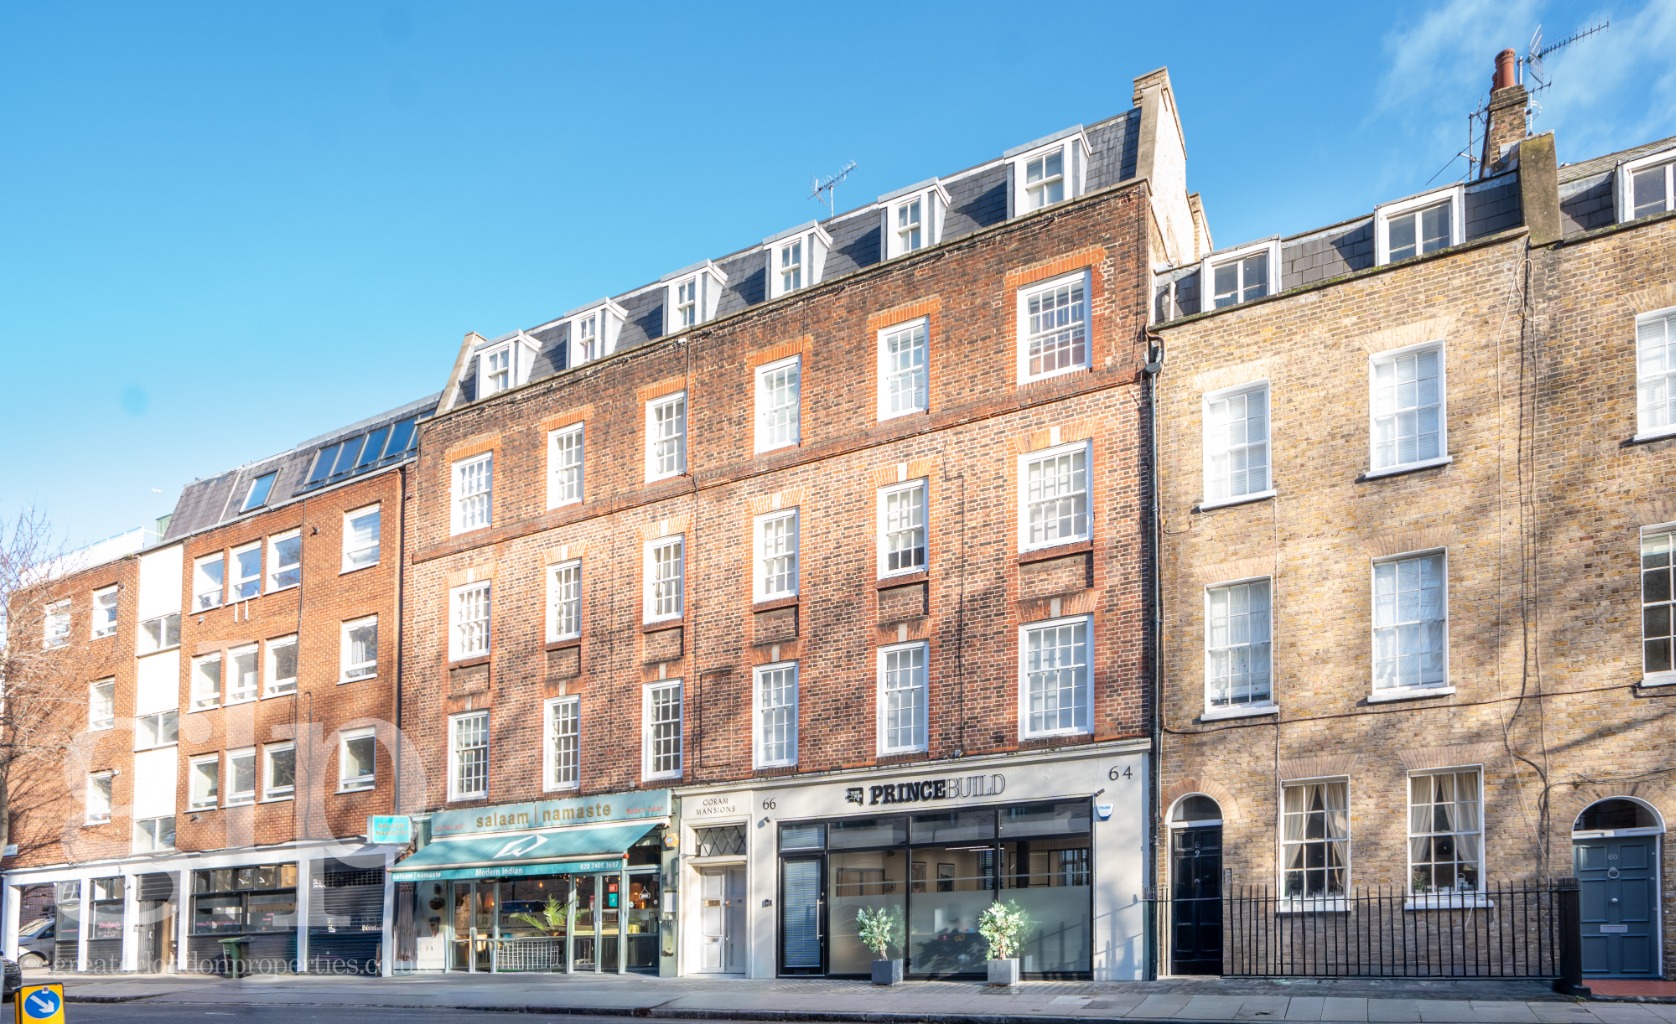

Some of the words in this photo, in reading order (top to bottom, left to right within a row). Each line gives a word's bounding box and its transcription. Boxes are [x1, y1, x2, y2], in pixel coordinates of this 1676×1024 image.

[1109, 765, 1133, 781] 64
[702, 797, 729, 806] CORAM
[762, 797, 777, 810] 66
[476, 811, 529, 828] salaam
[542, 802, 612, 822] namaste
[696, 805, 736, 816] MANSIONS
[475, 867, 500, 876] Modern
[502, 866, 523, 875] Indian
